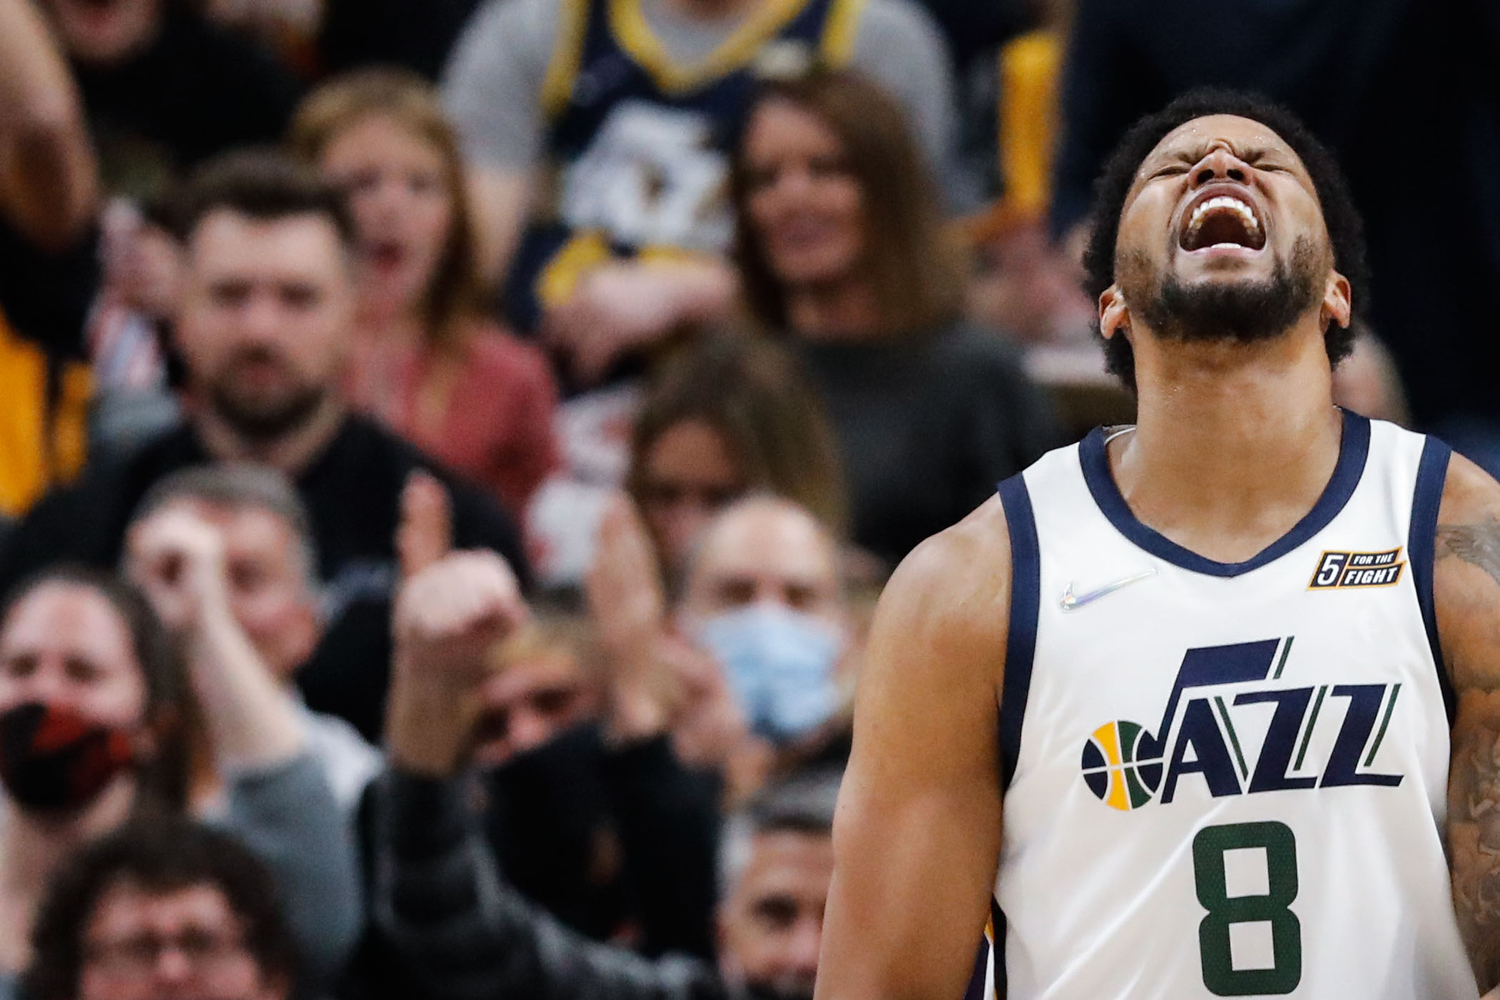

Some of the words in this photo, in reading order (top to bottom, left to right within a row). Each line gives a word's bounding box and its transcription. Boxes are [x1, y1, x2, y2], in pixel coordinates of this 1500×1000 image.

[1316, 554, 1344, 586] 5
[1352, 555, 1374, 565] FOR
[1374, 552, 1395, 564] THE
[1343, 566, 1399, 585] FIGHT
[1081, 635, 1405, 812] JAZZ
[1192, 820, 1303, 998] 8
